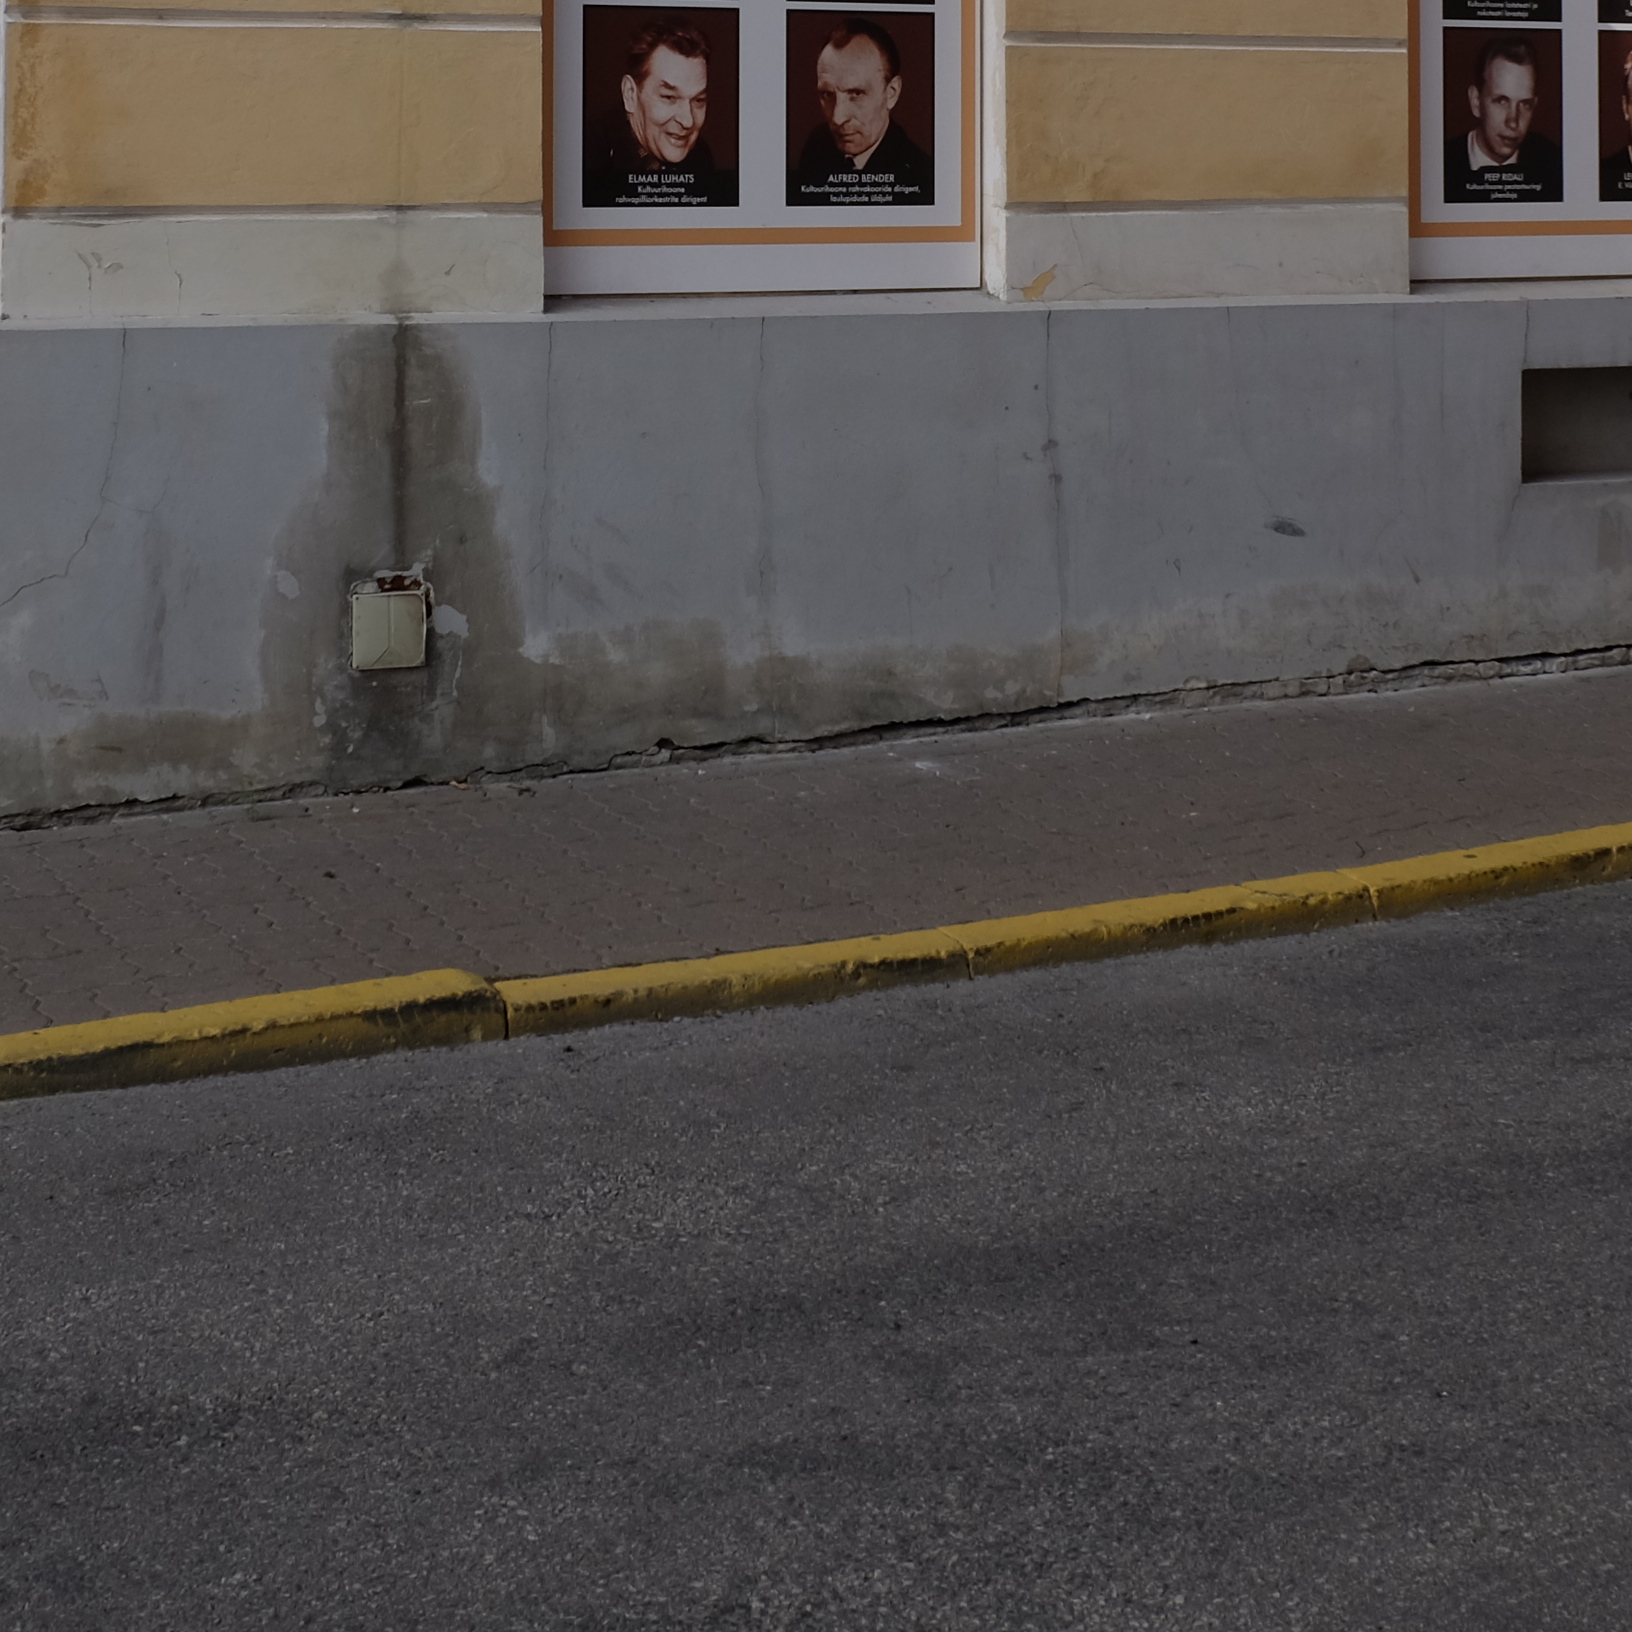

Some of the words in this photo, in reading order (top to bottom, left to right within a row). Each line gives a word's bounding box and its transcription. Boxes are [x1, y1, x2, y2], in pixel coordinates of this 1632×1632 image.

[628, 174, 658, 183] ELMAR
[661, 174, 694, 183] LUHATS
[827, 174, 859, 182] ALFRED
[862, 174, 894, 182] BENDER
[681, 196, 707, 204] dirigent
